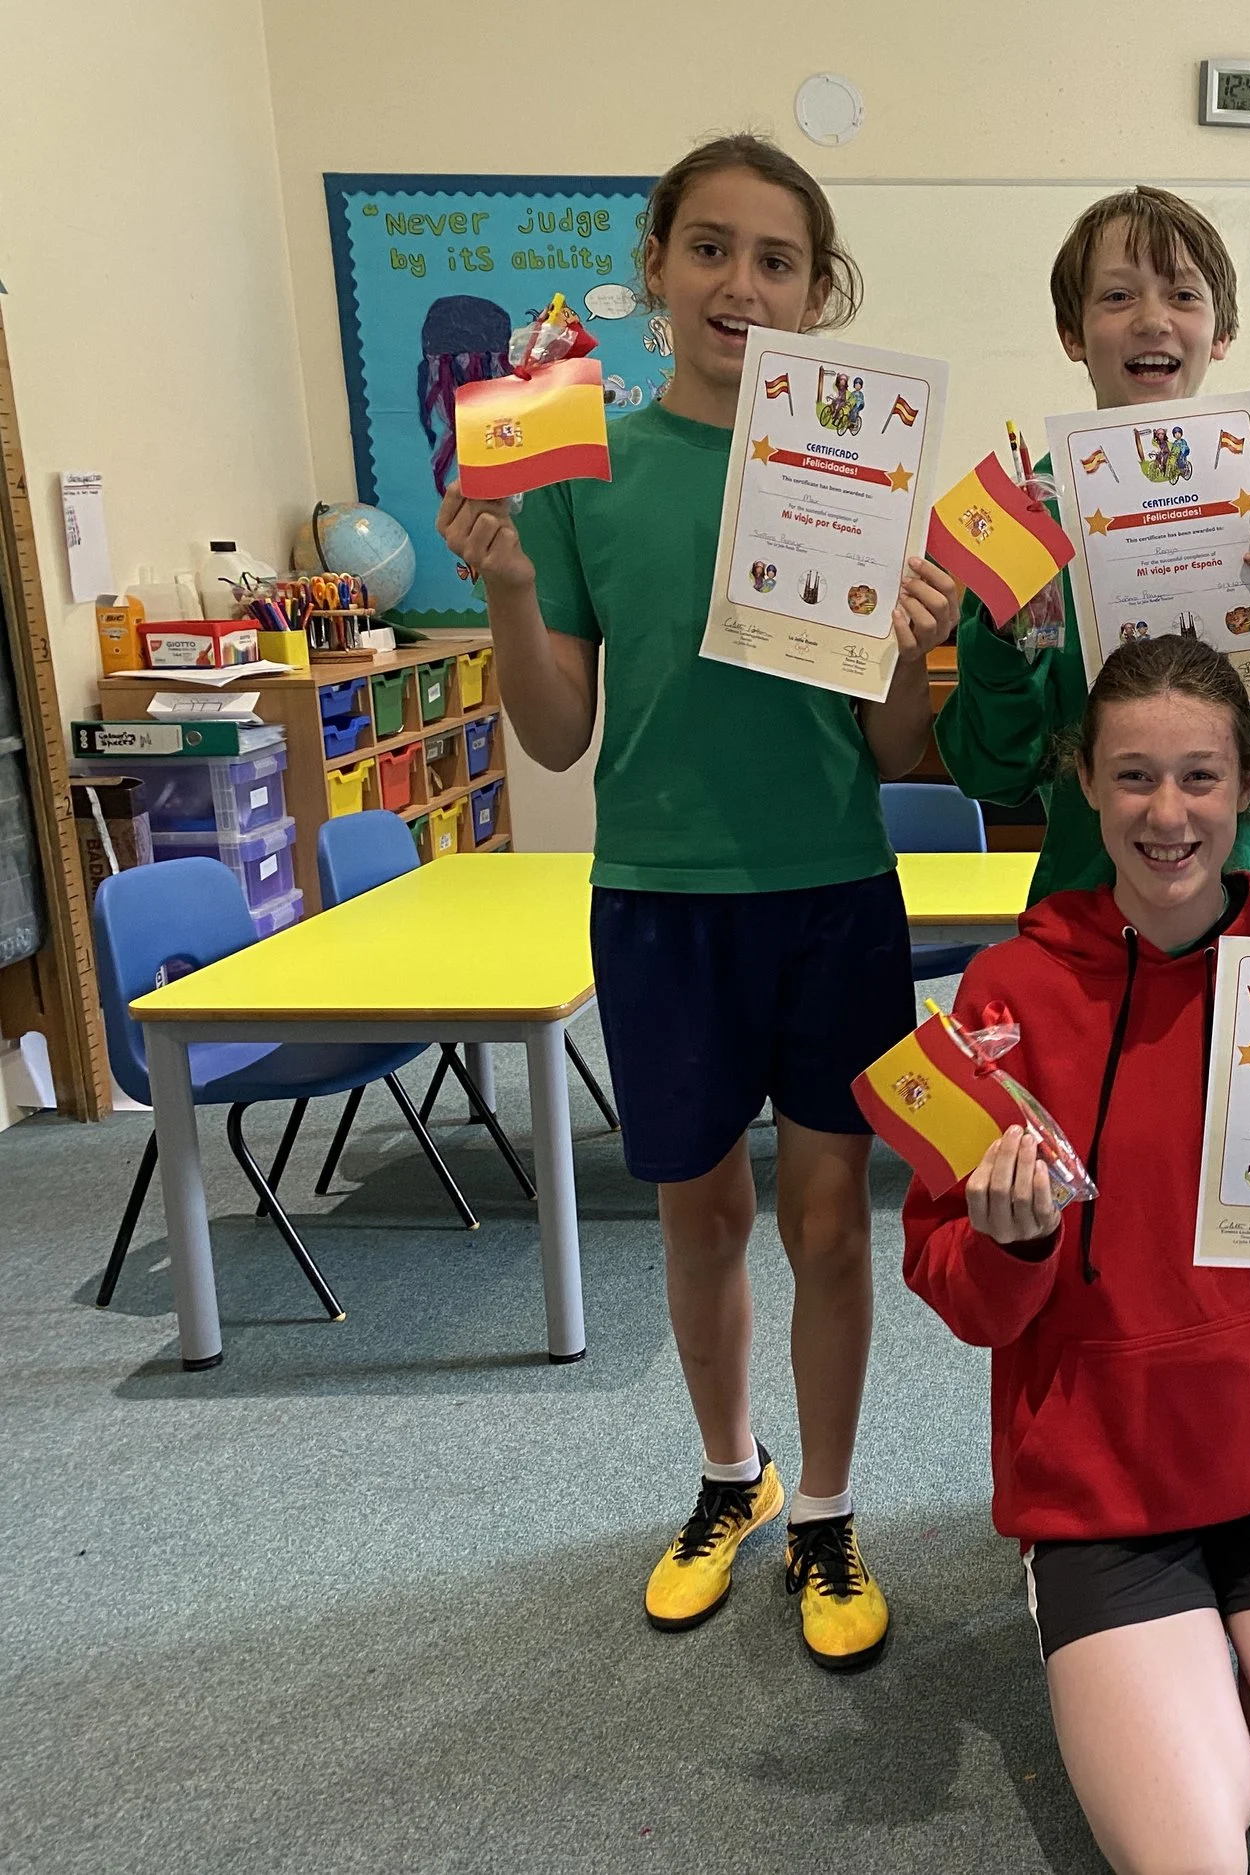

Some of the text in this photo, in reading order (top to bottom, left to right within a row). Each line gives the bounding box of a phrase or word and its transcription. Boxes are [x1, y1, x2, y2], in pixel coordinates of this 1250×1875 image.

[518, 207, 611, 237] judge
[389, 247, 427, 278] by
[511, 244, 613, 275] ability
[805, 442, 859, 460] CERTIFICADO
[801, 456, 858, 474] ¡Felicidades!
[781, 474, 792, 482] This
[792, 478, 818, 487] certificate
[1141, 494, 1198, 508] CERTIFICADO
[781, 509, 862, 536] Mi viaje por España
[1142, 506, 1202, 524] ¡Felicidades!
[1138, 533, 1166, 541] certificate
[1136, 557, 1222, 576] Mi viaje por España
[40, 638, 48, 658] 3
[64, 795, 73, 816] 2
